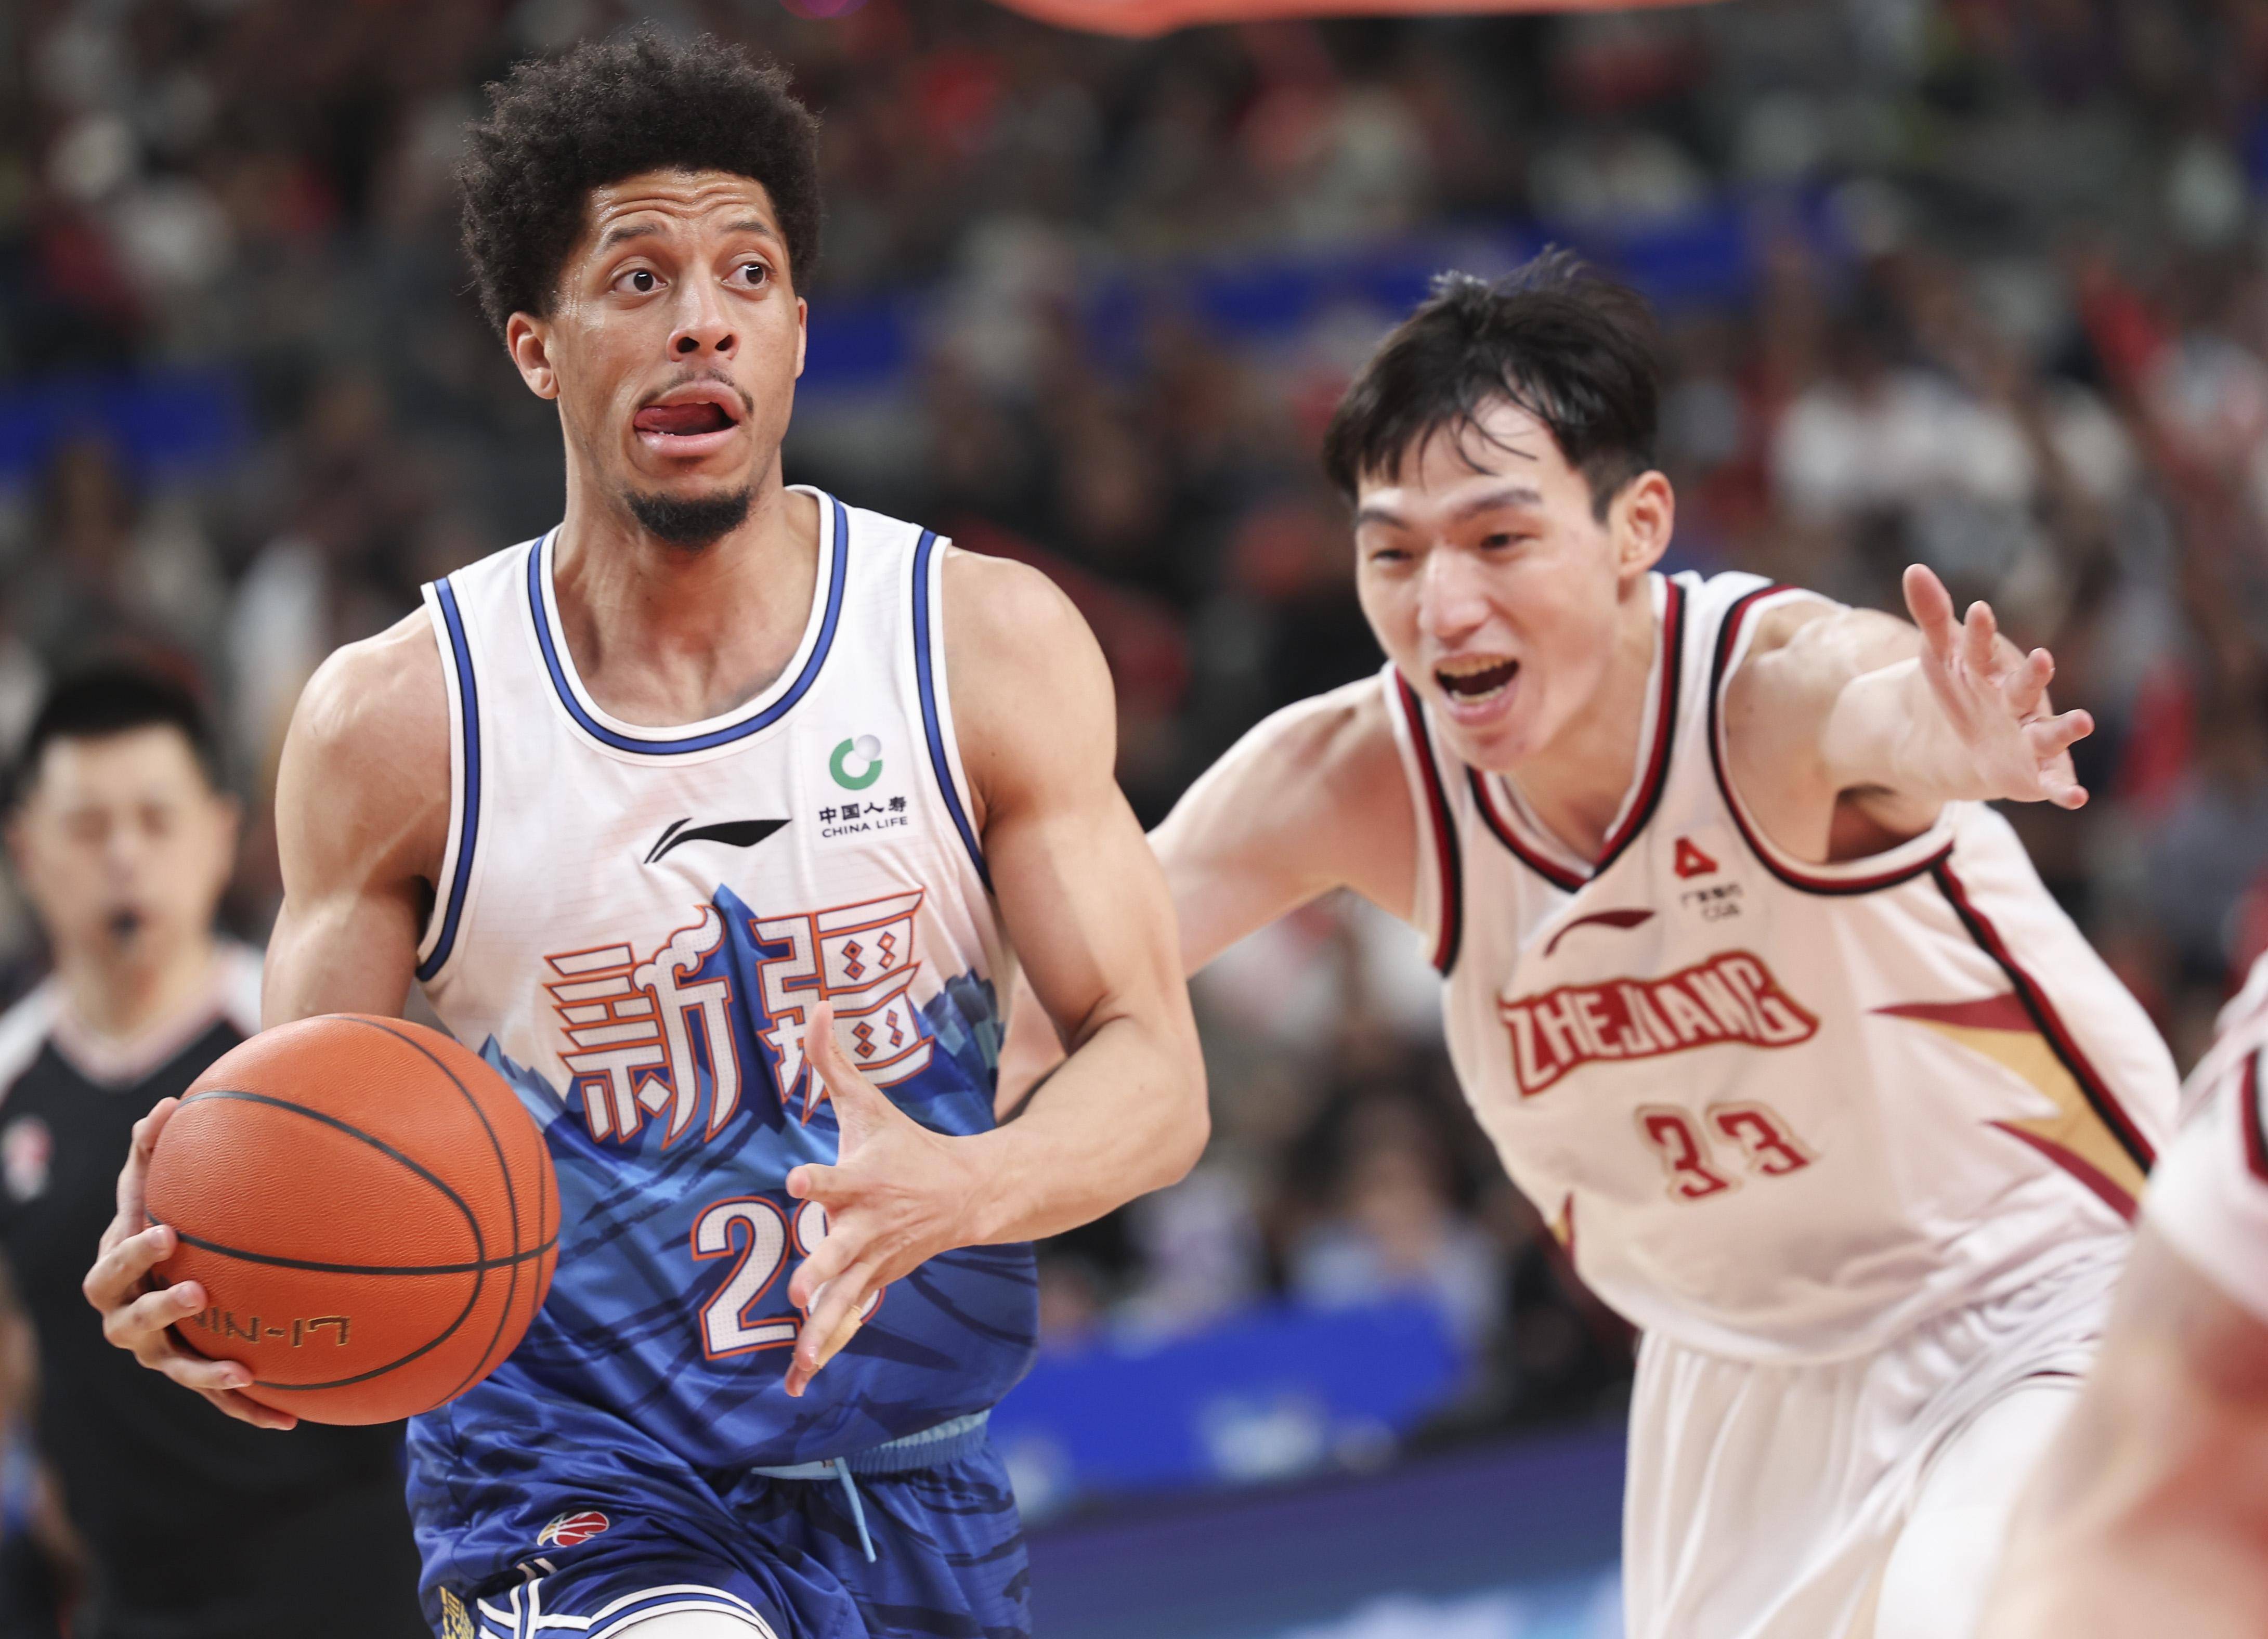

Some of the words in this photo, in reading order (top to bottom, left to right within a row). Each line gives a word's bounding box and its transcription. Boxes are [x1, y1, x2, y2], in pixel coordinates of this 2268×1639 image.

[819, 796, 906, 824] 中国人寿
[822, 822, 871, 838] CHINA
[876, 816, 908, 829] LIFE
[543, 889, 935, 1150] 新疆
[1499, 950, 1818, 1097] ZHEJIANG
[1639, 1107, 1815, 1201] 33
[191, 1306, 351, 1348] LI-NI
